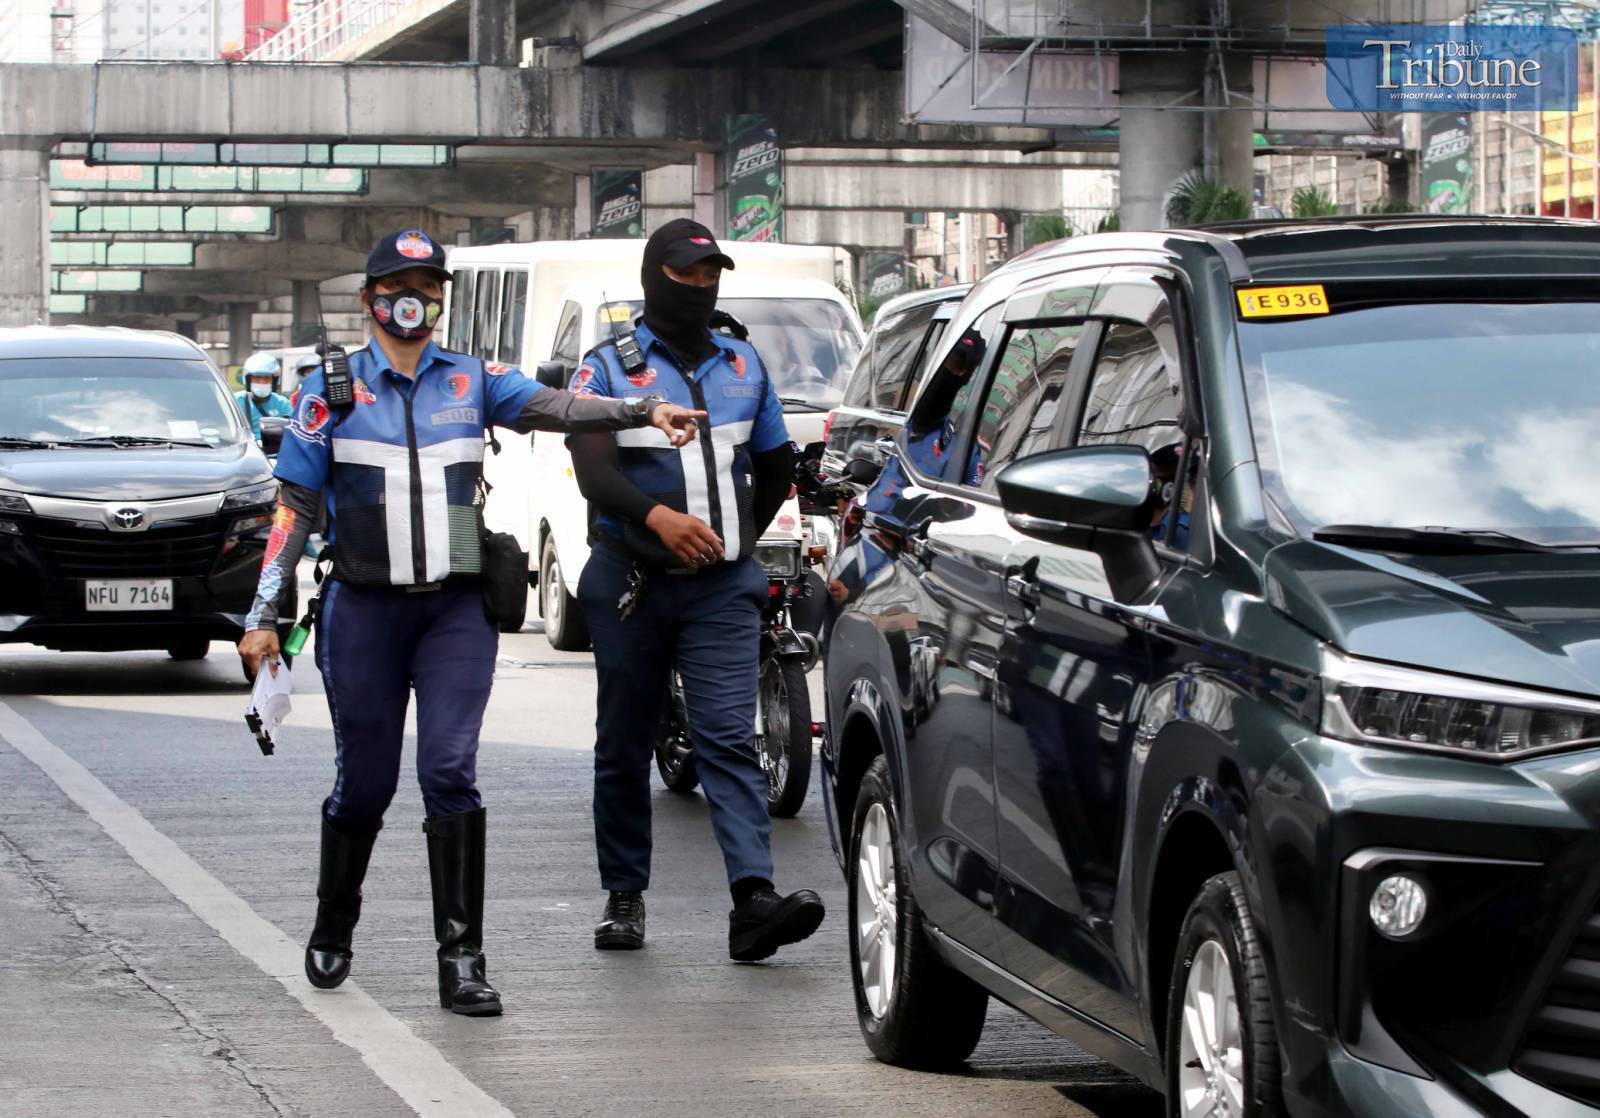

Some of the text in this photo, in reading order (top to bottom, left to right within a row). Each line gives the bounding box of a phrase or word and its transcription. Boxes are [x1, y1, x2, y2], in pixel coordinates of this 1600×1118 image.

[733, 148, 779, 174] zero
[599, 202, 640, 224] zero
[1258, 292, 1322, 309] E936
[88, 586, 170, 604] NFU 7164
